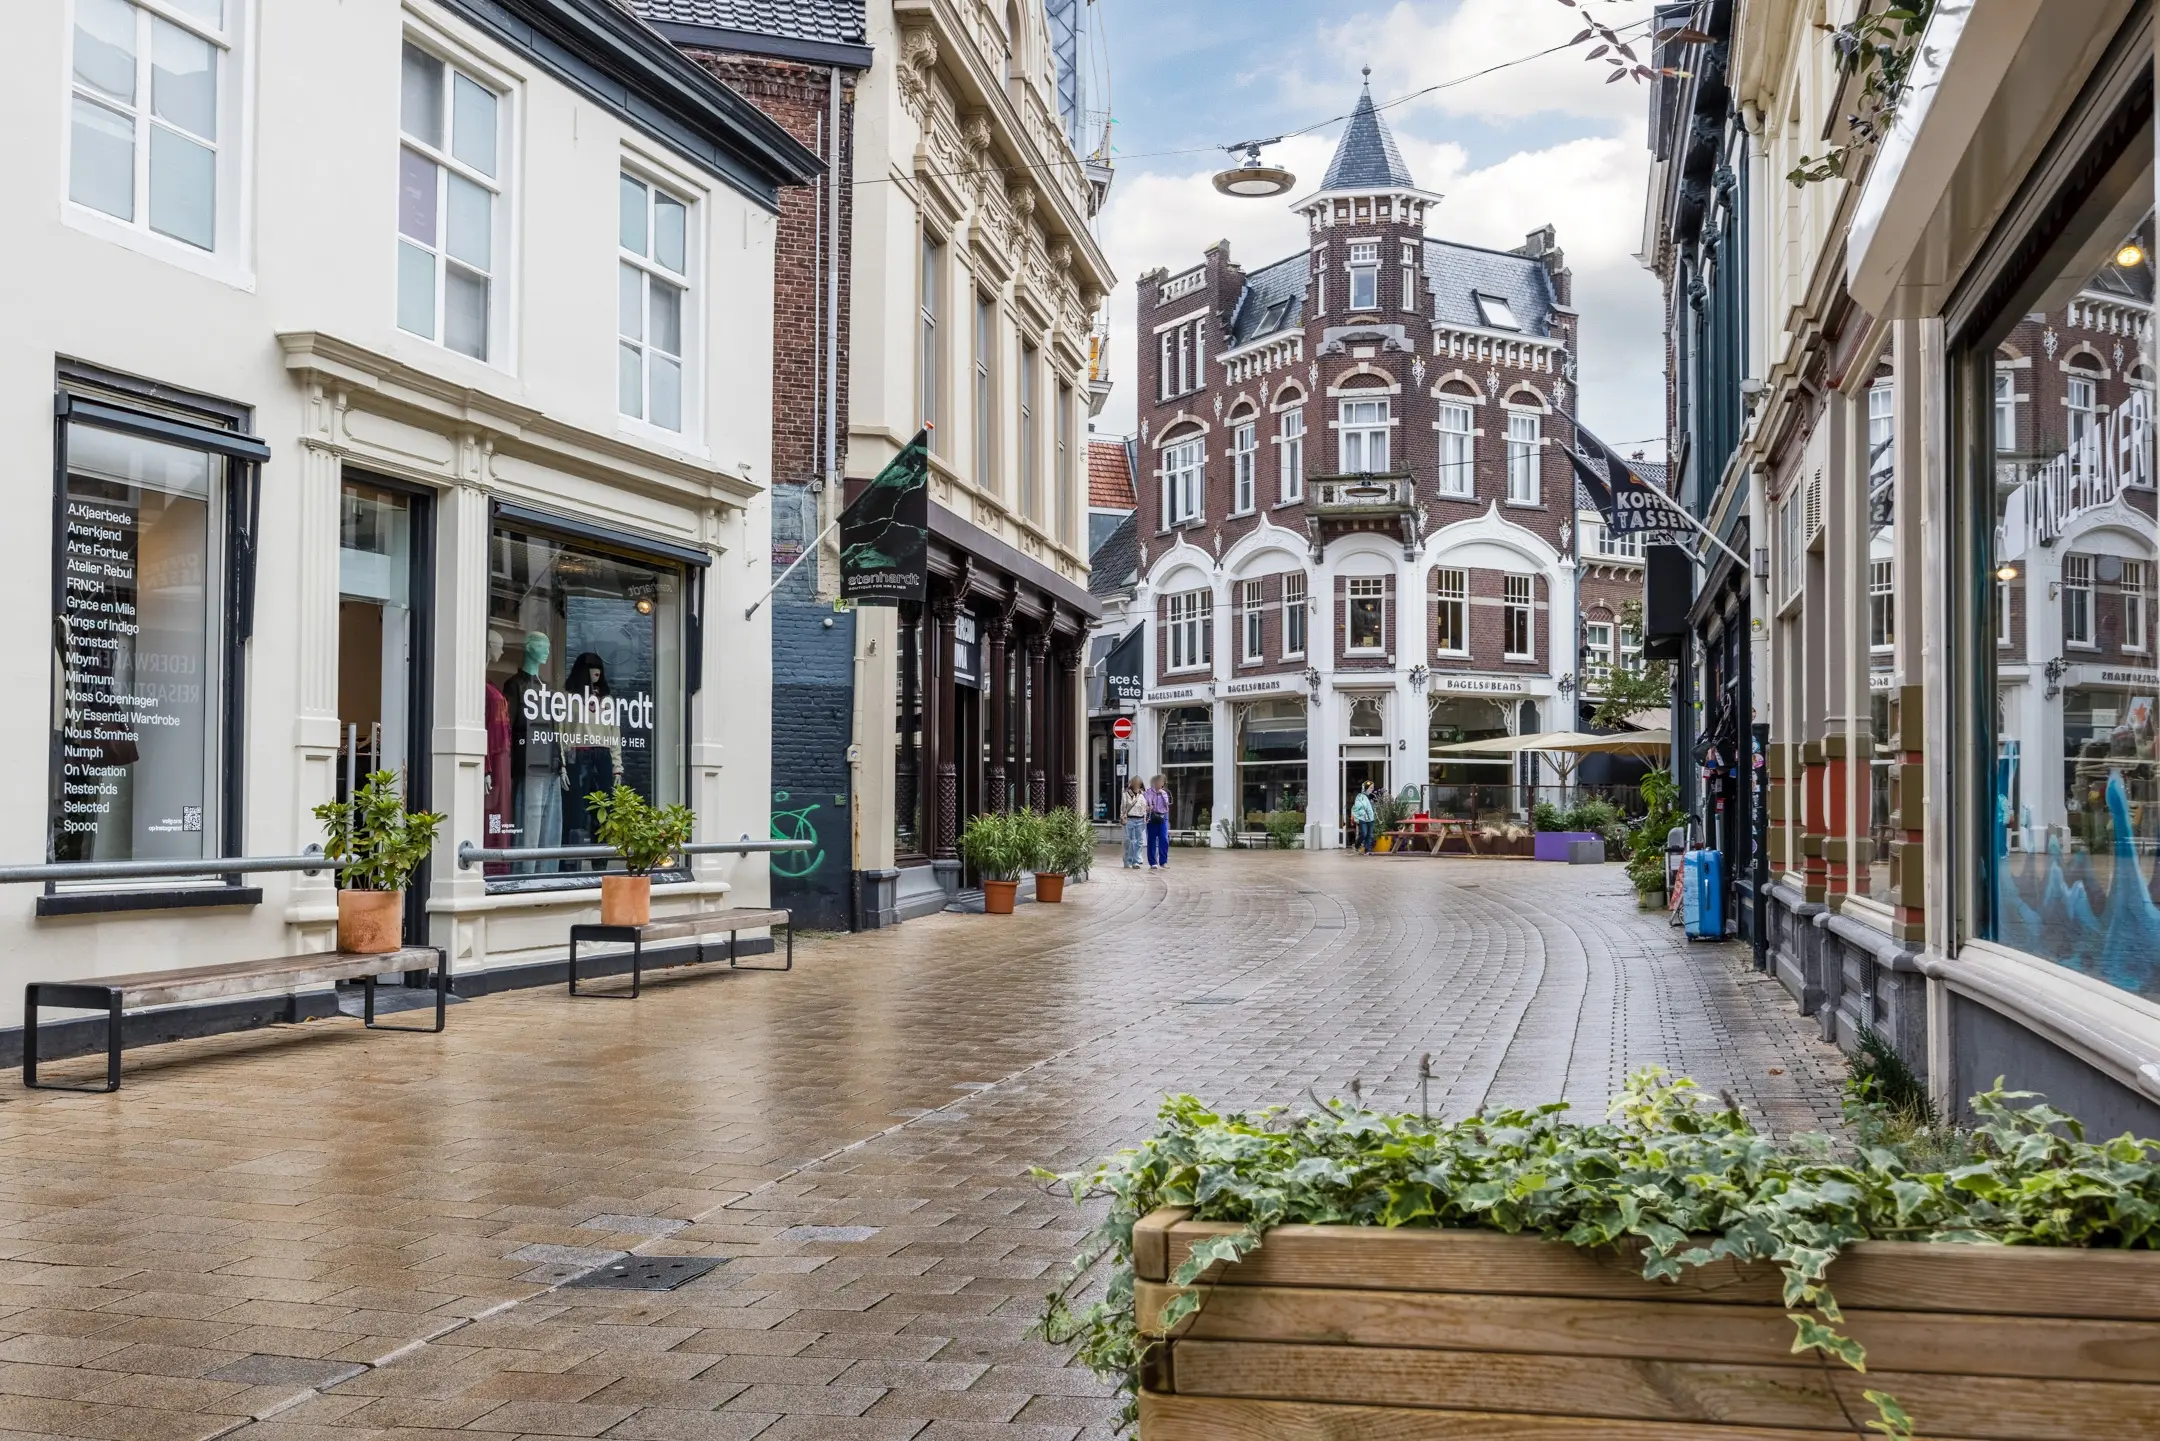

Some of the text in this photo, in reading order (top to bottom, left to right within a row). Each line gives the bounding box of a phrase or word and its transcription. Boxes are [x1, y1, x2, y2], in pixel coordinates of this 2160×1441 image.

[67, 503, 132, 525] A.Kjaerbede
[1617, 509, 1693, 530] TASSEN
[67, 521, 122, 541] Anerkjend
[67, 540, 129, 560] Arte Fortue
[67, 558, 132, 579] Atelier Rebul
[66, 577, 104, 593] FRNCH
[848, 571, 920, 586] stenhardt
[66, 596, 136, 616] Grace en Mila
[66, 614, 140, 636] Kings of Indigo
[66, 633, 119, 650] Kronstadt
[66, 651, 99, 667] Mbym
[65, 670, 115, 686] Minimum
[1109, 675, 1140, 685] ace &
[65, 689, 159, 708] Moss Copenhagen
[1118, 685, 1141, 697] tate
[523, 684, 653, 729] stenhardt
[65, 707, 181, 726] My Essential Wardrobe
[64, 727, 139, 742] Nous Sommes
[534, 731, 581, 744] BOUTIQUE
[583, 734, 601, 745] FOR
[603, 735, 619, 746] HIM
[621, 737, 627, 747] &
[629, 738, 645, 748] HER
[64, 745, 104, 760] Numph
[1399, 740, 1406, 750] 2
[64, 763, 127, 777] On Vacation
[64, 781, 118, 795] Resteröds
[64, 801, 110, 813] Selected
[63, 819, 98, 834] Spooq
